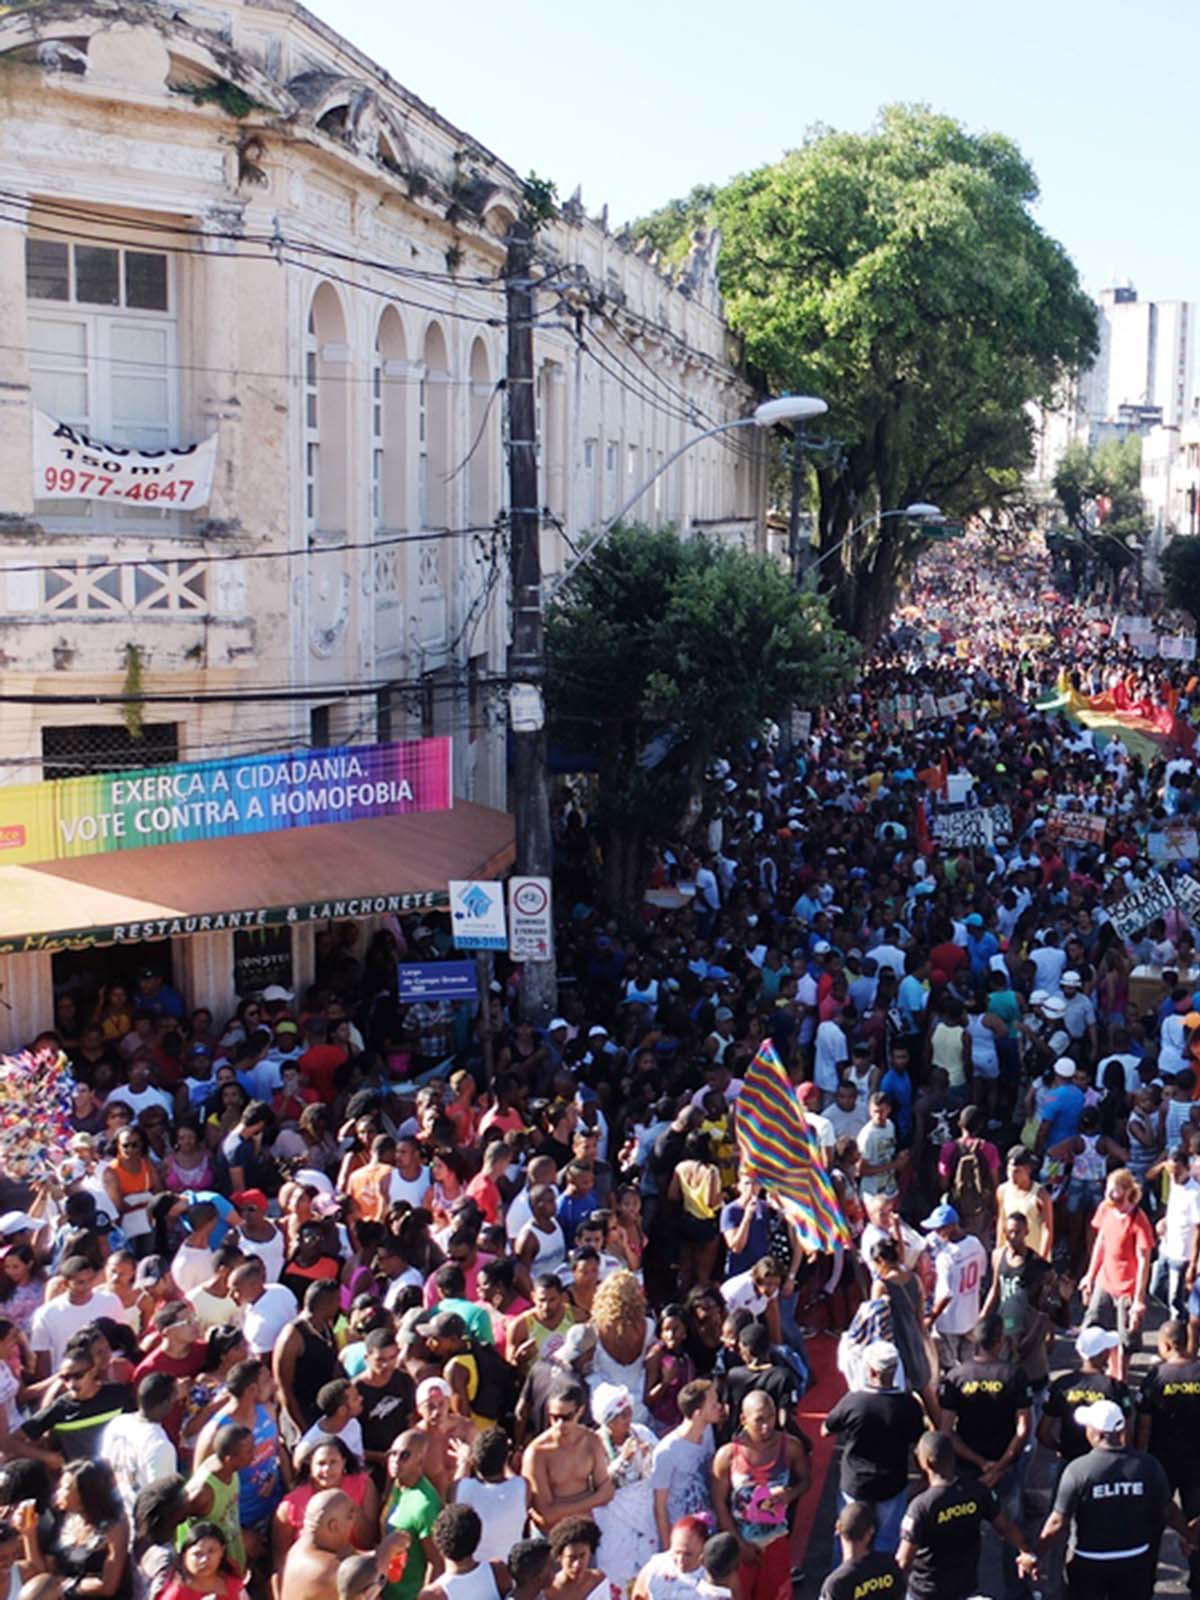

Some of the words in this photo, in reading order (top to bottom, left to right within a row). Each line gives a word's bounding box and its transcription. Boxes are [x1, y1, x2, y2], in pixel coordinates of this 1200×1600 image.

[60, 449, 123, 474] 150
[44, 467, 195, 503] 9977-4647
[111, 773, 205, 806] EXERÇA
[211, 770, 230, 793] A
[235, 756, 369, 791] CIDADANIA.
[60, 811, 127, 843] VOTE
[134, 799, 240, 834] CONTRA
[246, 796, 265, 819] A
[271, 779, 414, 817] HOMOFOBIA
[113, 909, 267, 941] RESTAURANTE
[287, 907, 299, 921] &
[309, 892, 434, 919] LANCHONETE
[958, 1260, 979, 1294] 10
[961, 1380, 1003, 1395] APOIO
[1092, 1482, 1144, 1499] ELITE
[937, 1501, 977, 1525] APOIO
[854, 1573, 894, 1600] APOIO
